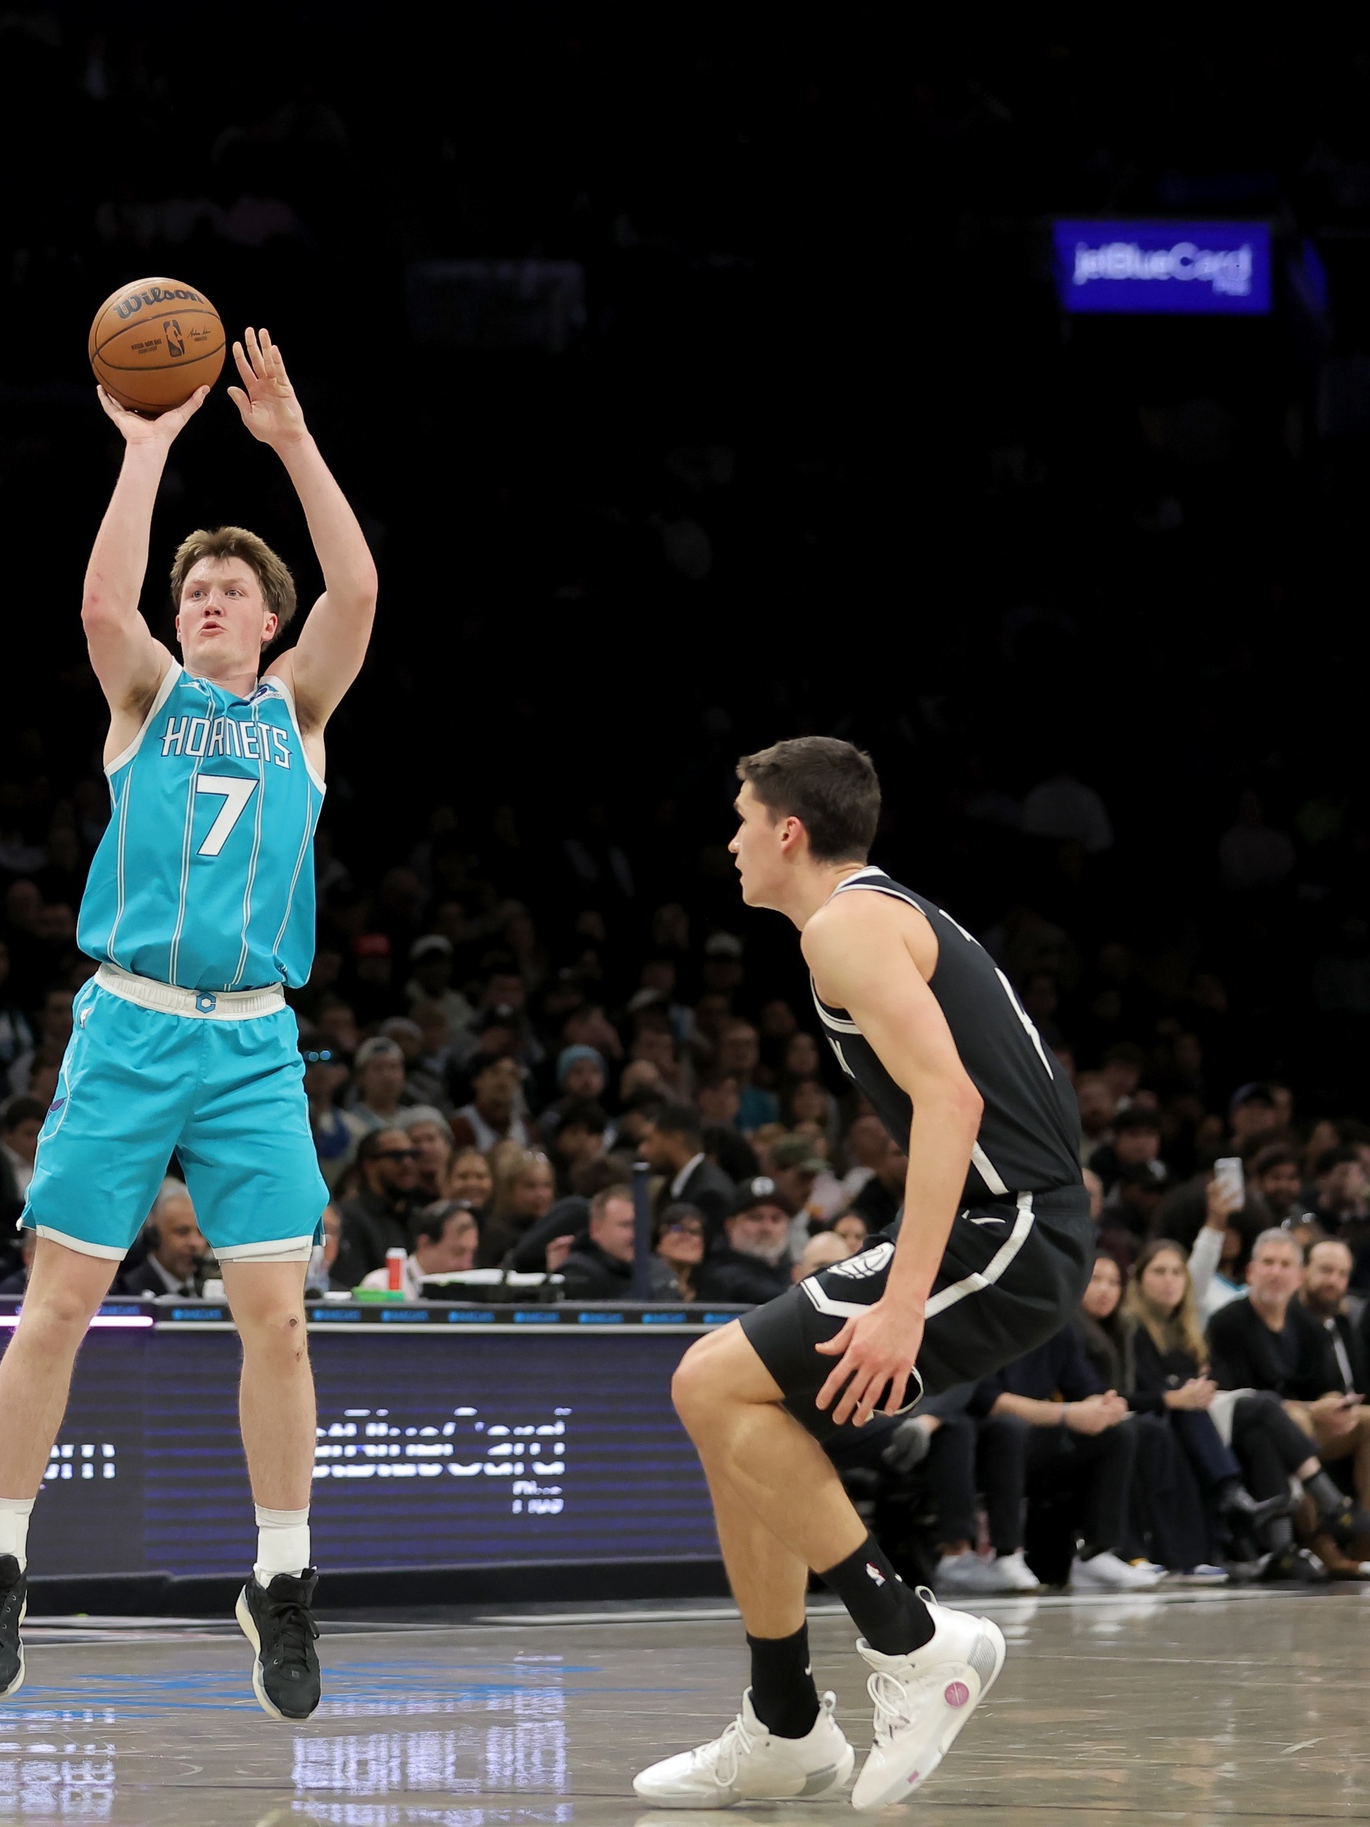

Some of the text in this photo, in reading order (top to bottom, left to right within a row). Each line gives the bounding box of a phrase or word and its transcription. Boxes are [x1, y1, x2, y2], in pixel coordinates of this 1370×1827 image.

[113, 287, 205, 319] Wilson
[160, 715, 293, 770] HORNETS
[196, 773, 260, 857] 7
